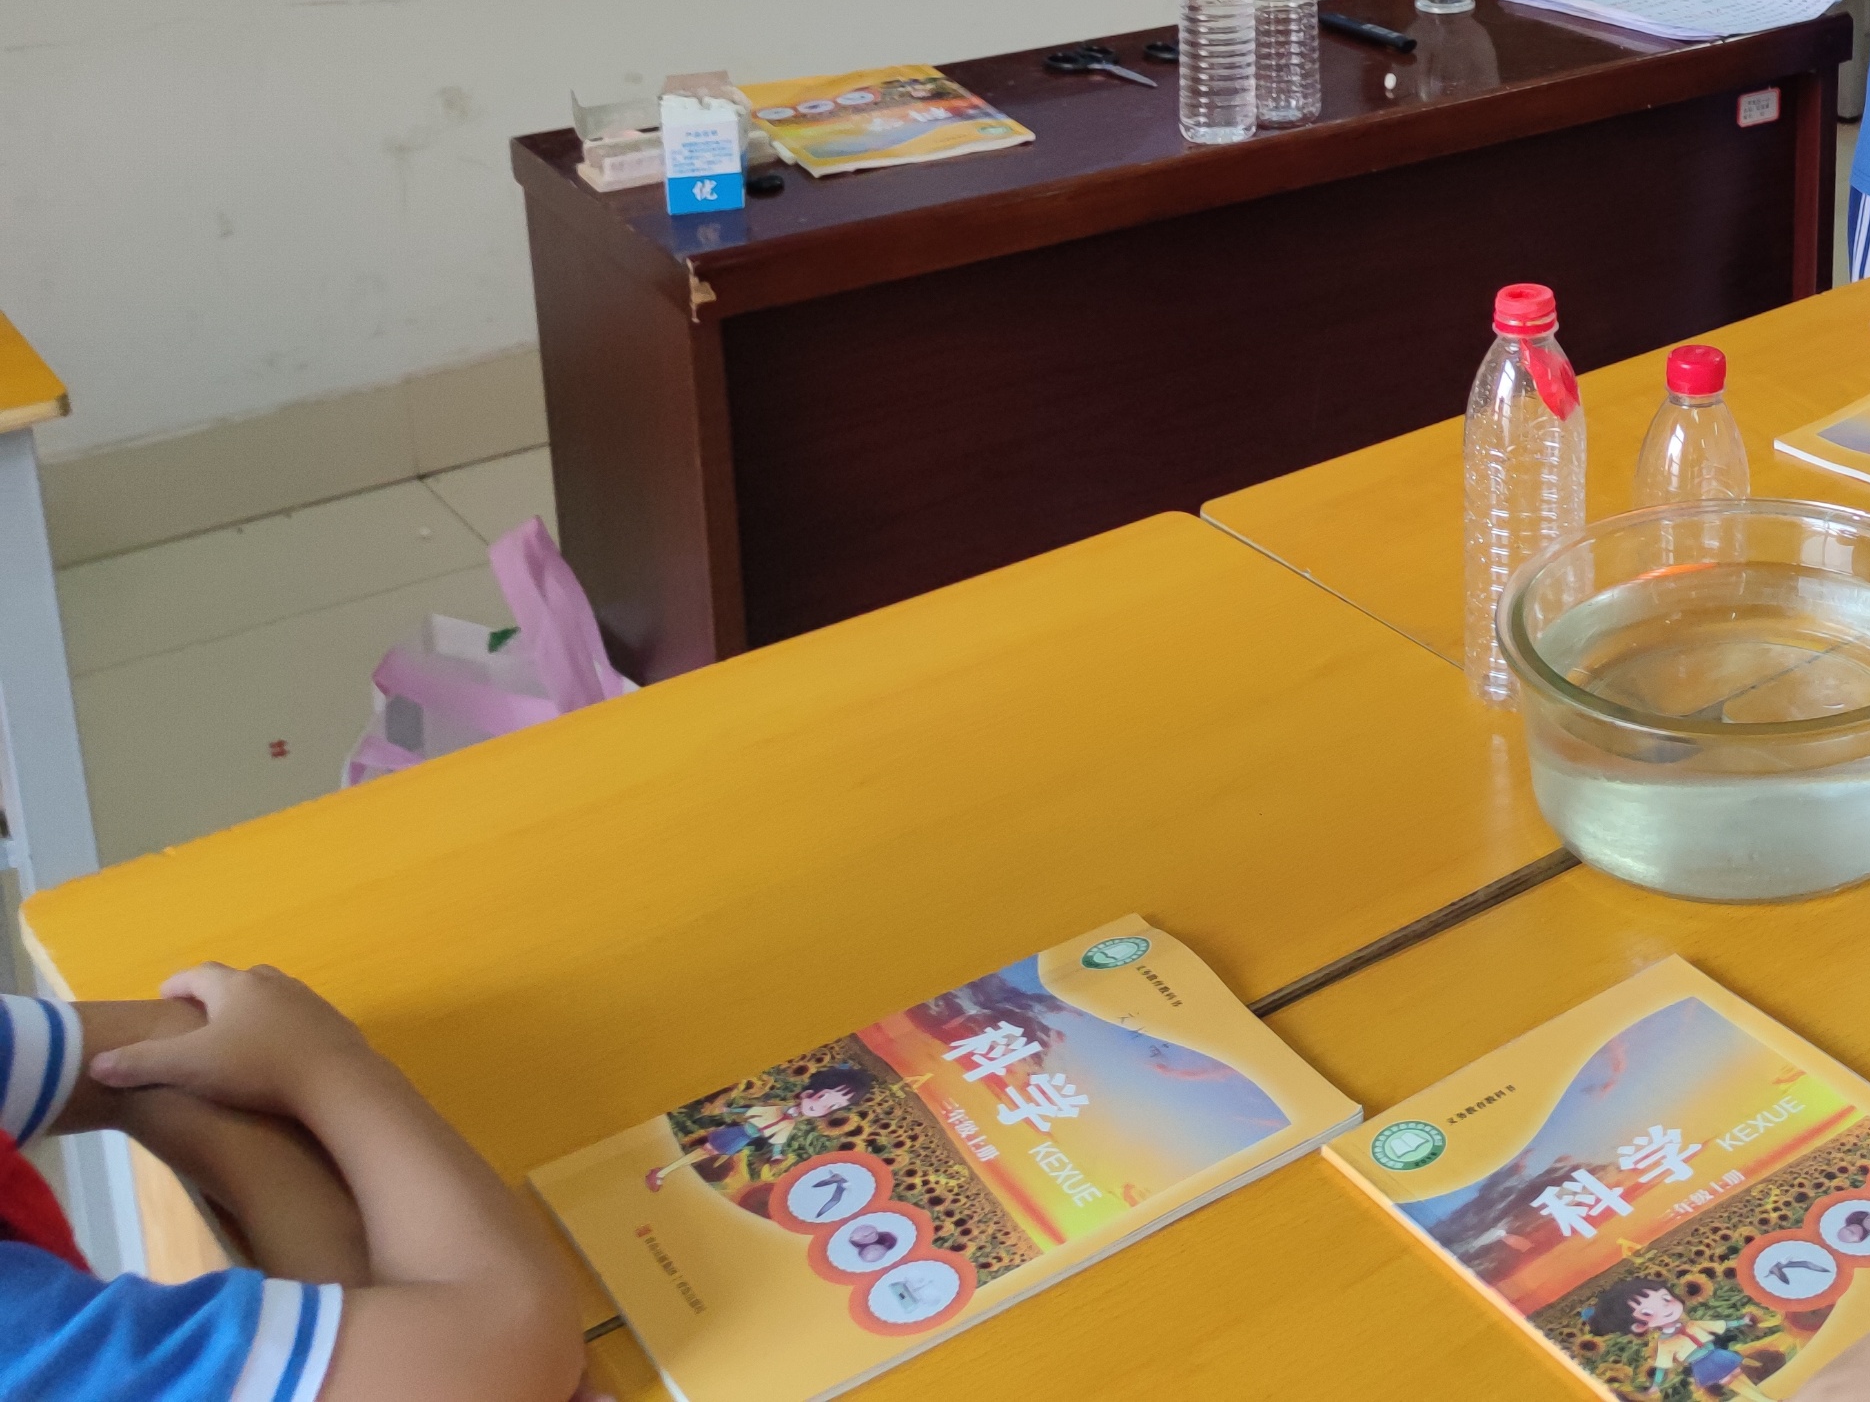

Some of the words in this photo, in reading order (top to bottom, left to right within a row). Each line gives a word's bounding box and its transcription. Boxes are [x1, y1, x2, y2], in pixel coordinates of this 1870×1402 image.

[940, 1018, 1091, 1133] 科学
[1715, 1095, 1806, 1154] KEXUE
[1027, 1141, 1102, 1209] KEXUE
[1530, 1123, 1702, 1241] 科学
